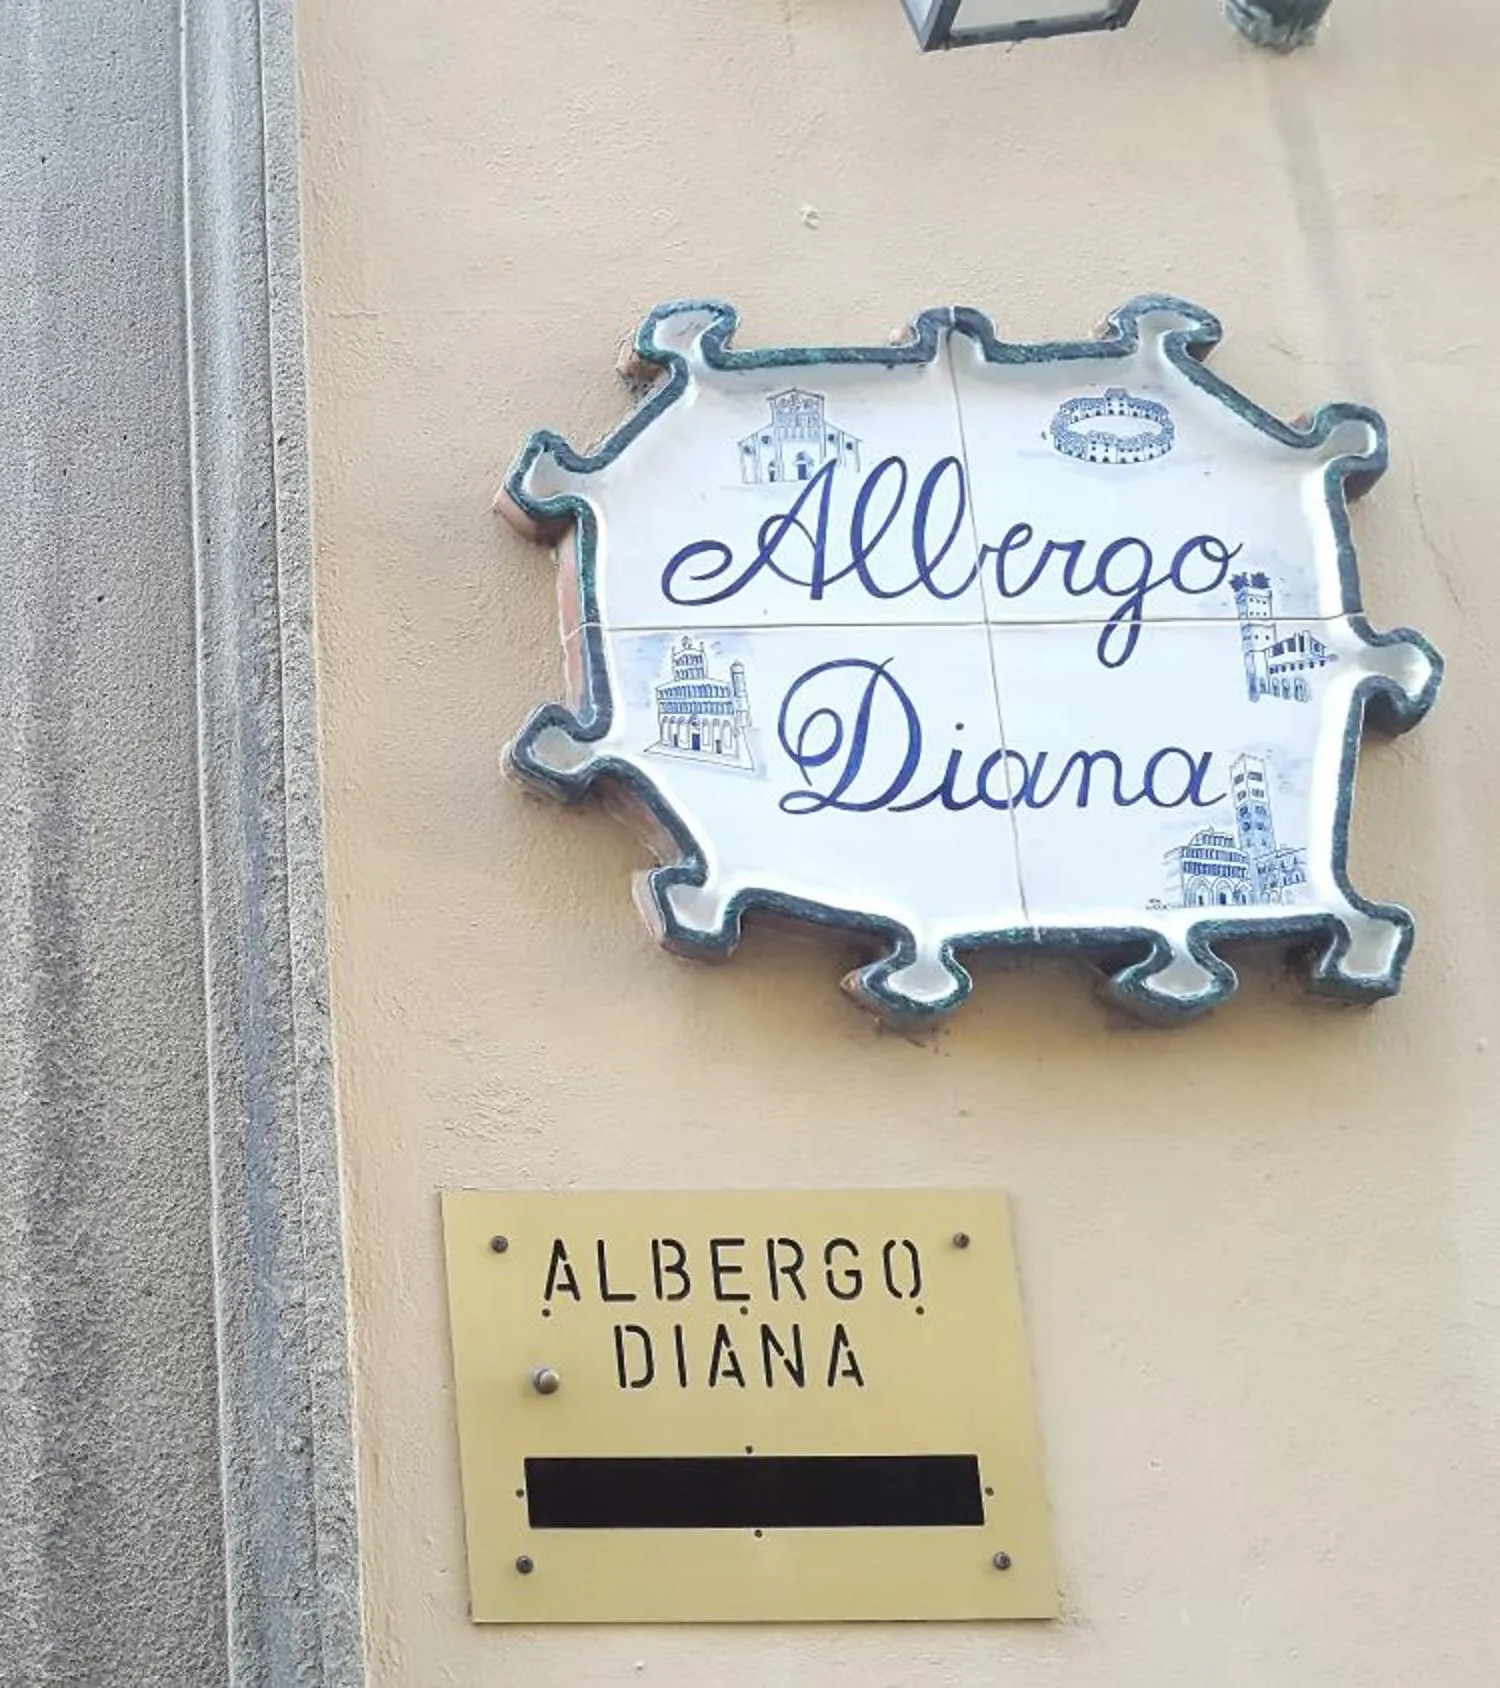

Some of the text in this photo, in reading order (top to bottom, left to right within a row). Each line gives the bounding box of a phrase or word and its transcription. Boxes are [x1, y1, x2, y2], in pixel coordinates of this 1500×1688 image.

[661, 455, 1243, 668] Albergo
[777, 656, 1228, 815] Diana
[543, 1238, 924, 1302] ALBERGO
[613, 1323, 866, 1389] DIANA
